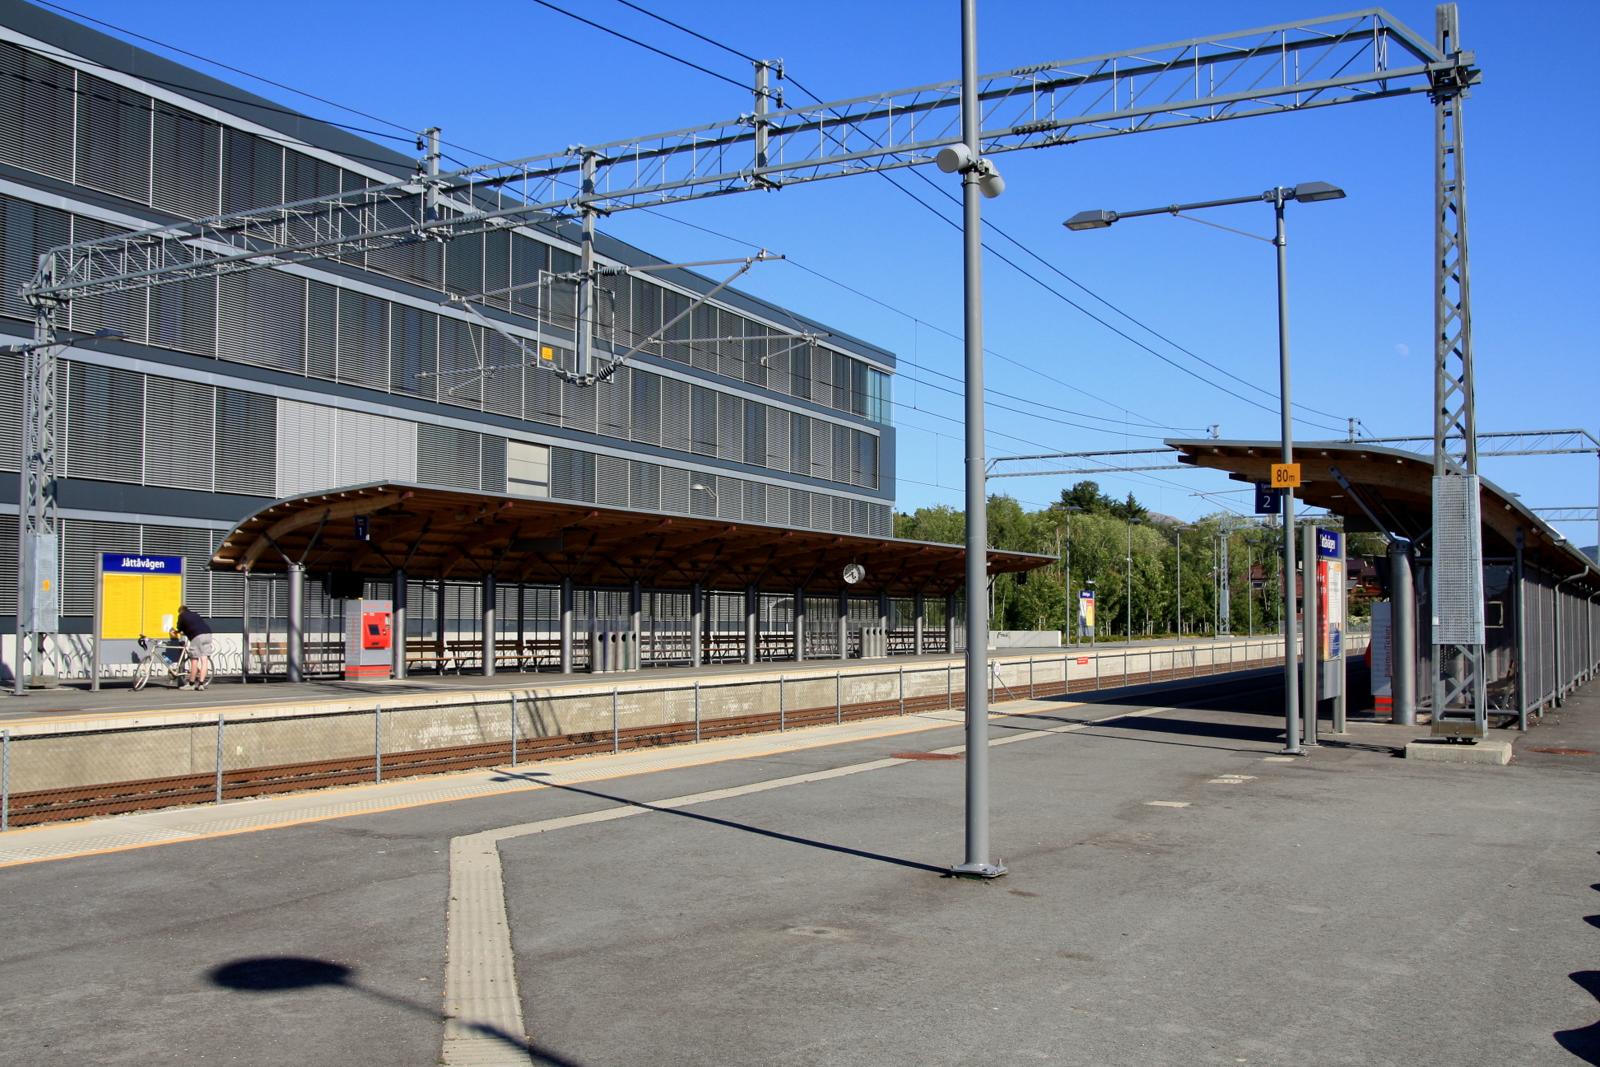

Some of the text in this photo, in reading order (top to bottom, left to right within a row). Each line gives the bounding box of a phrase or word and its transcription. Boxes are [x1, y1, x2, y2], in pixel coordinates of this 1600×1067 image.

[1276, 469, 1295, 482] 80m
[1263, 495, 1271, 508] 2
[121, 557, 165, 570] Jåttåvågen
